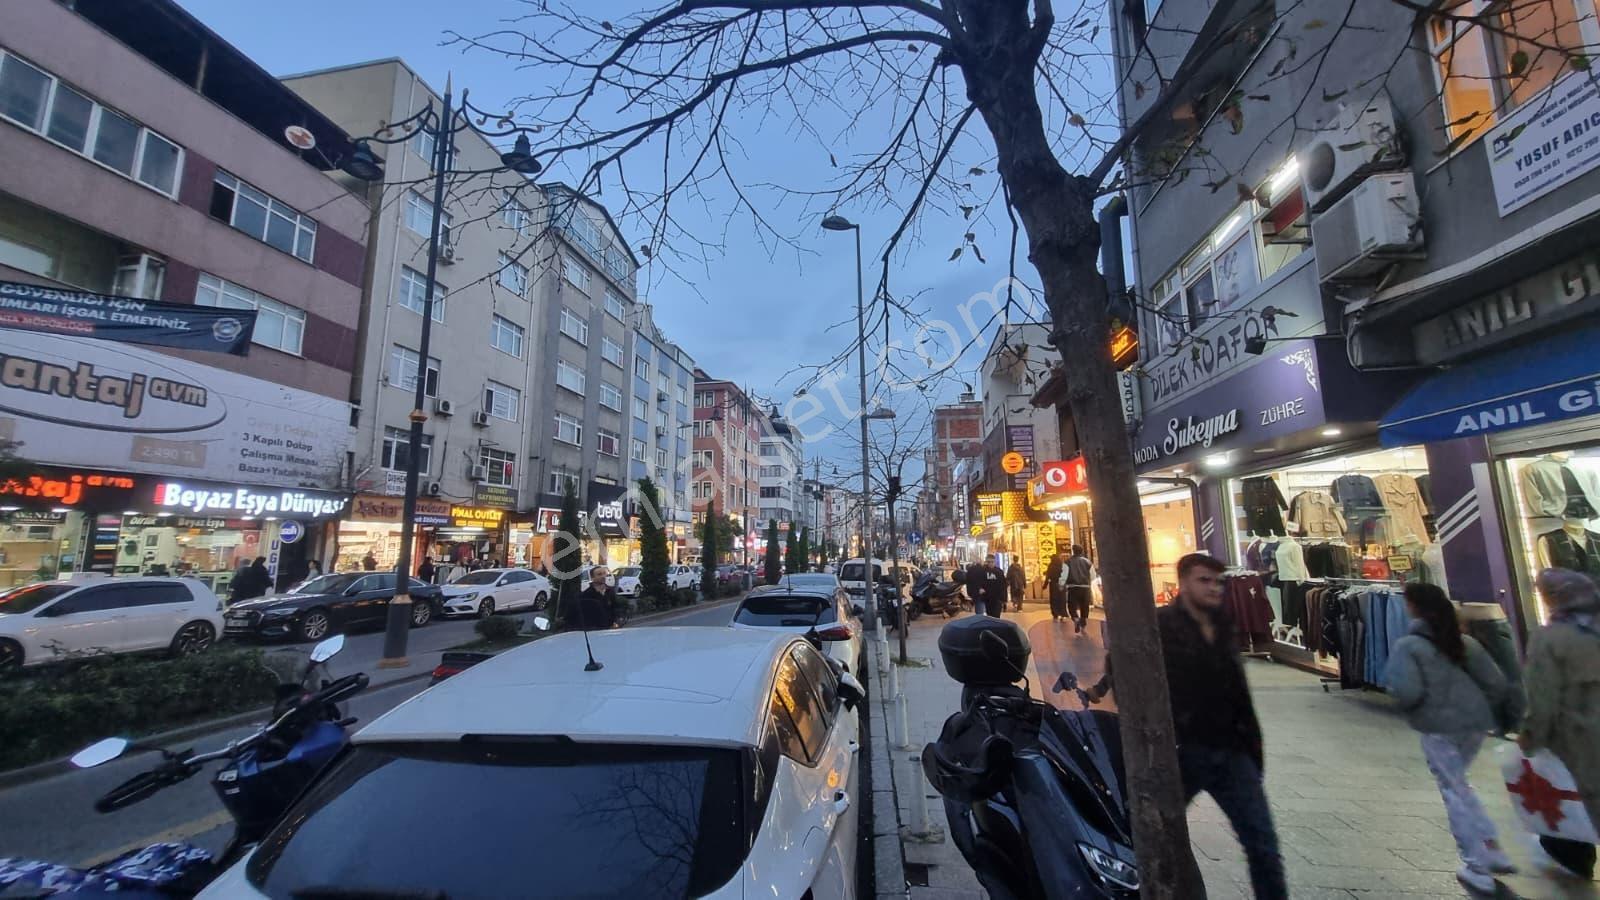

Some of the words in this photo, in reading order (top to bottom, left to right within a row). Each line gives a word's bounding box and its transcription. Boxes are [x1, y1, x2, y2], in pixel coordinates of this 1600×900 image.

[1515, 137, 1559, 171] YUSUF
[0, 298, 57, 313] IMLARI
[62, 304, 107, 320] İŞGAL
[111, 312, 191, 331] ETMEYİNİZ.
[108, 296, 146, 312] İÇİN
[0, 353, 147, 418] antaj
[149, 377, 208, 407] avm
[1151, 358, 1189, 402] DİLEK
[1454, 402, 1546, 434] ANIL
[243, 433, 249, 441] 3
[253, 435, 283, 446] Kapılı
[286, 440, 313, 452] Dolap
[1134, 445, 1158, 465] MODA
[1164, 408, 1239, 455] Sukeyna
[241, 448, 283, 460] Çalışma
[164, 484, 232, 512] Beyaz
[235, 489, 278, 515] Eşya
[280, 493, 348, 517] Dünyası
[475, 509, 503, 521] OUTLET
[598, 501, 623, 519] trend
